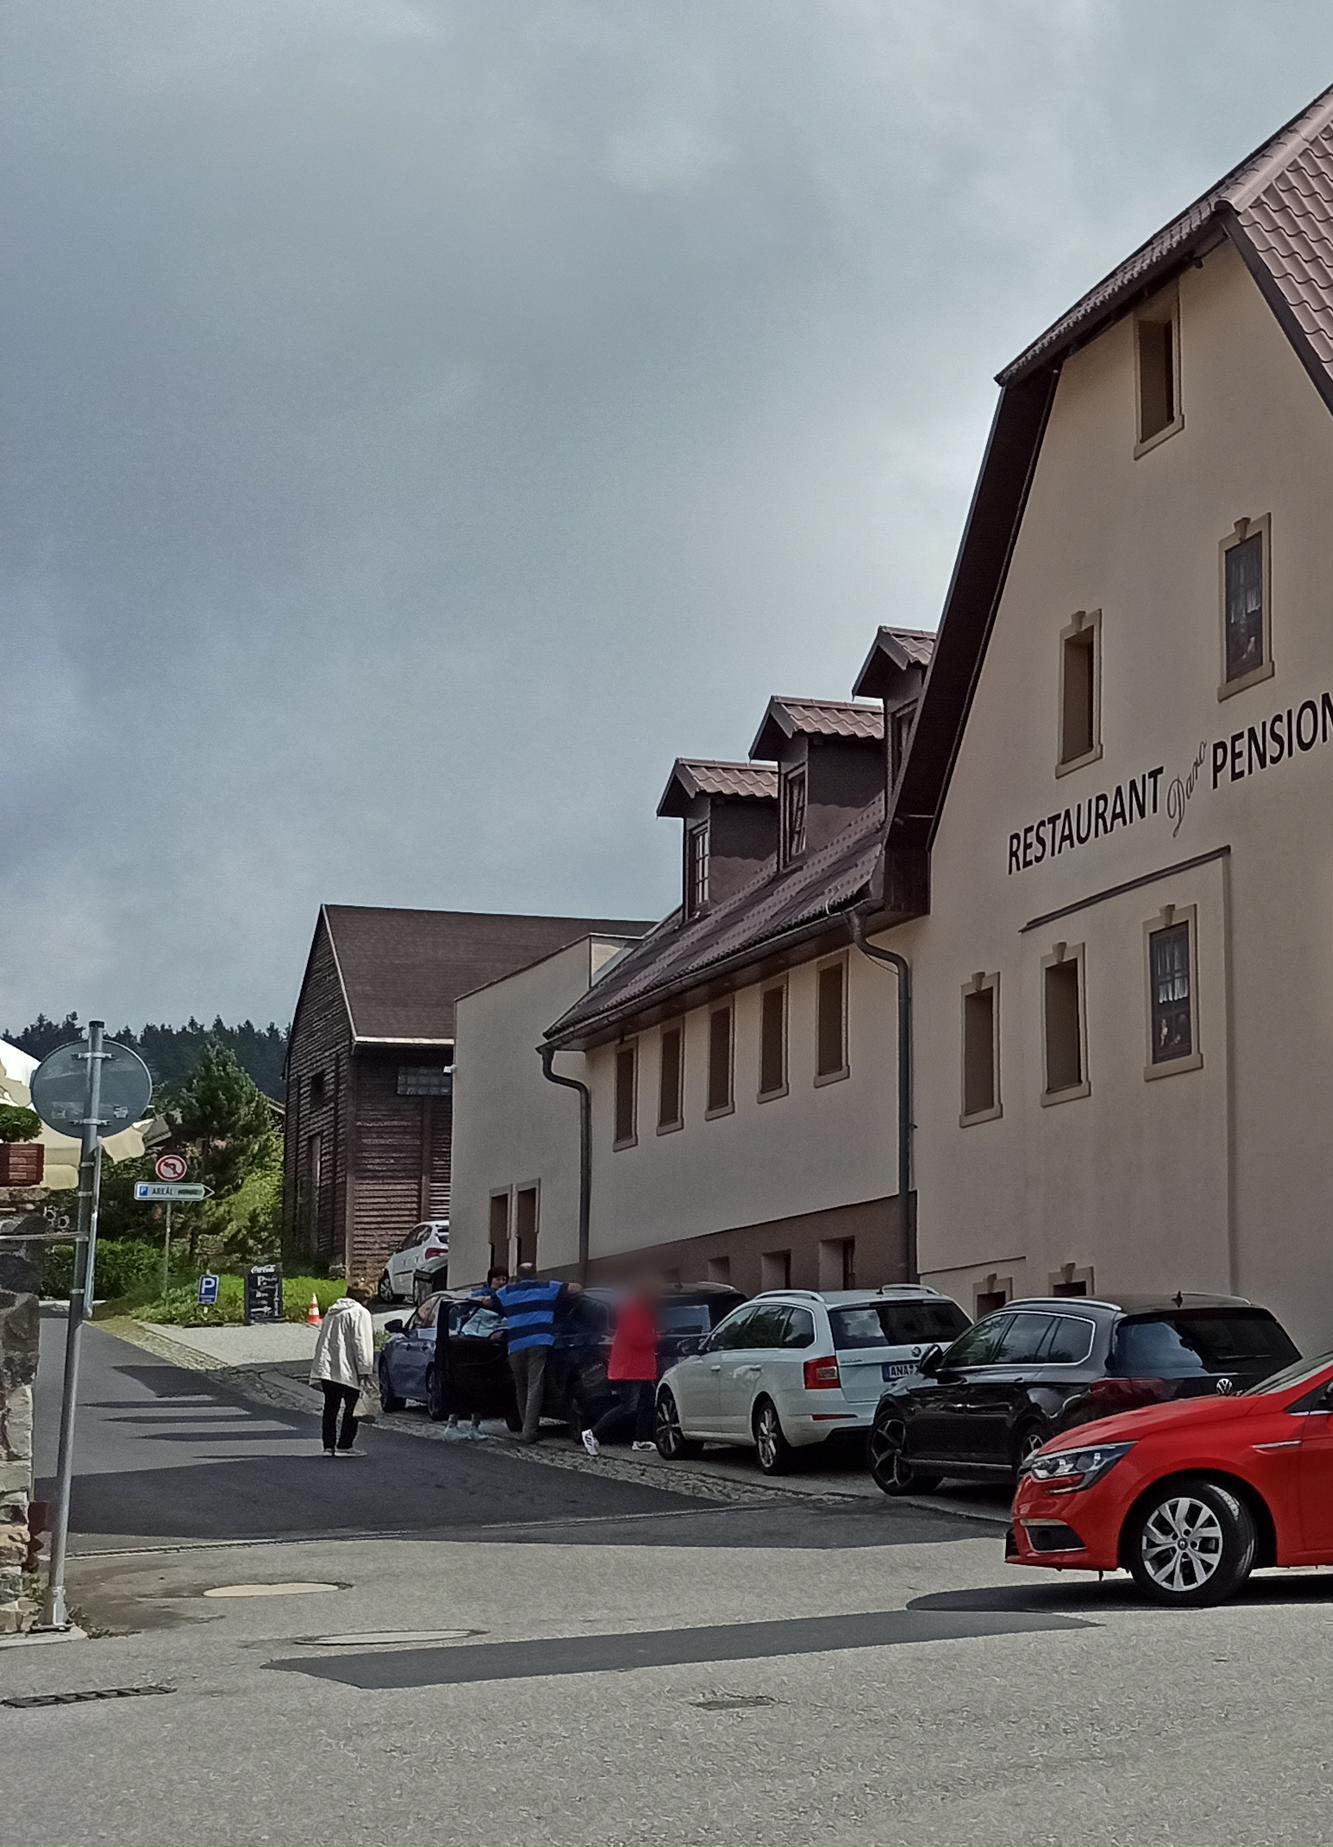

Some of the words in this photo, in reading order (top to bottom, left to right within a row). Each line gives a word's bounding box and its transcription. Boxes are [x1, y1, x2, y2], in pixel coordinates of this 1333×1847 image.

[1007, 765, 1165, 876] RESTAURANT
[1166, 739, 1208, 838] Daro
[201, 1277, 216, 1294] P
